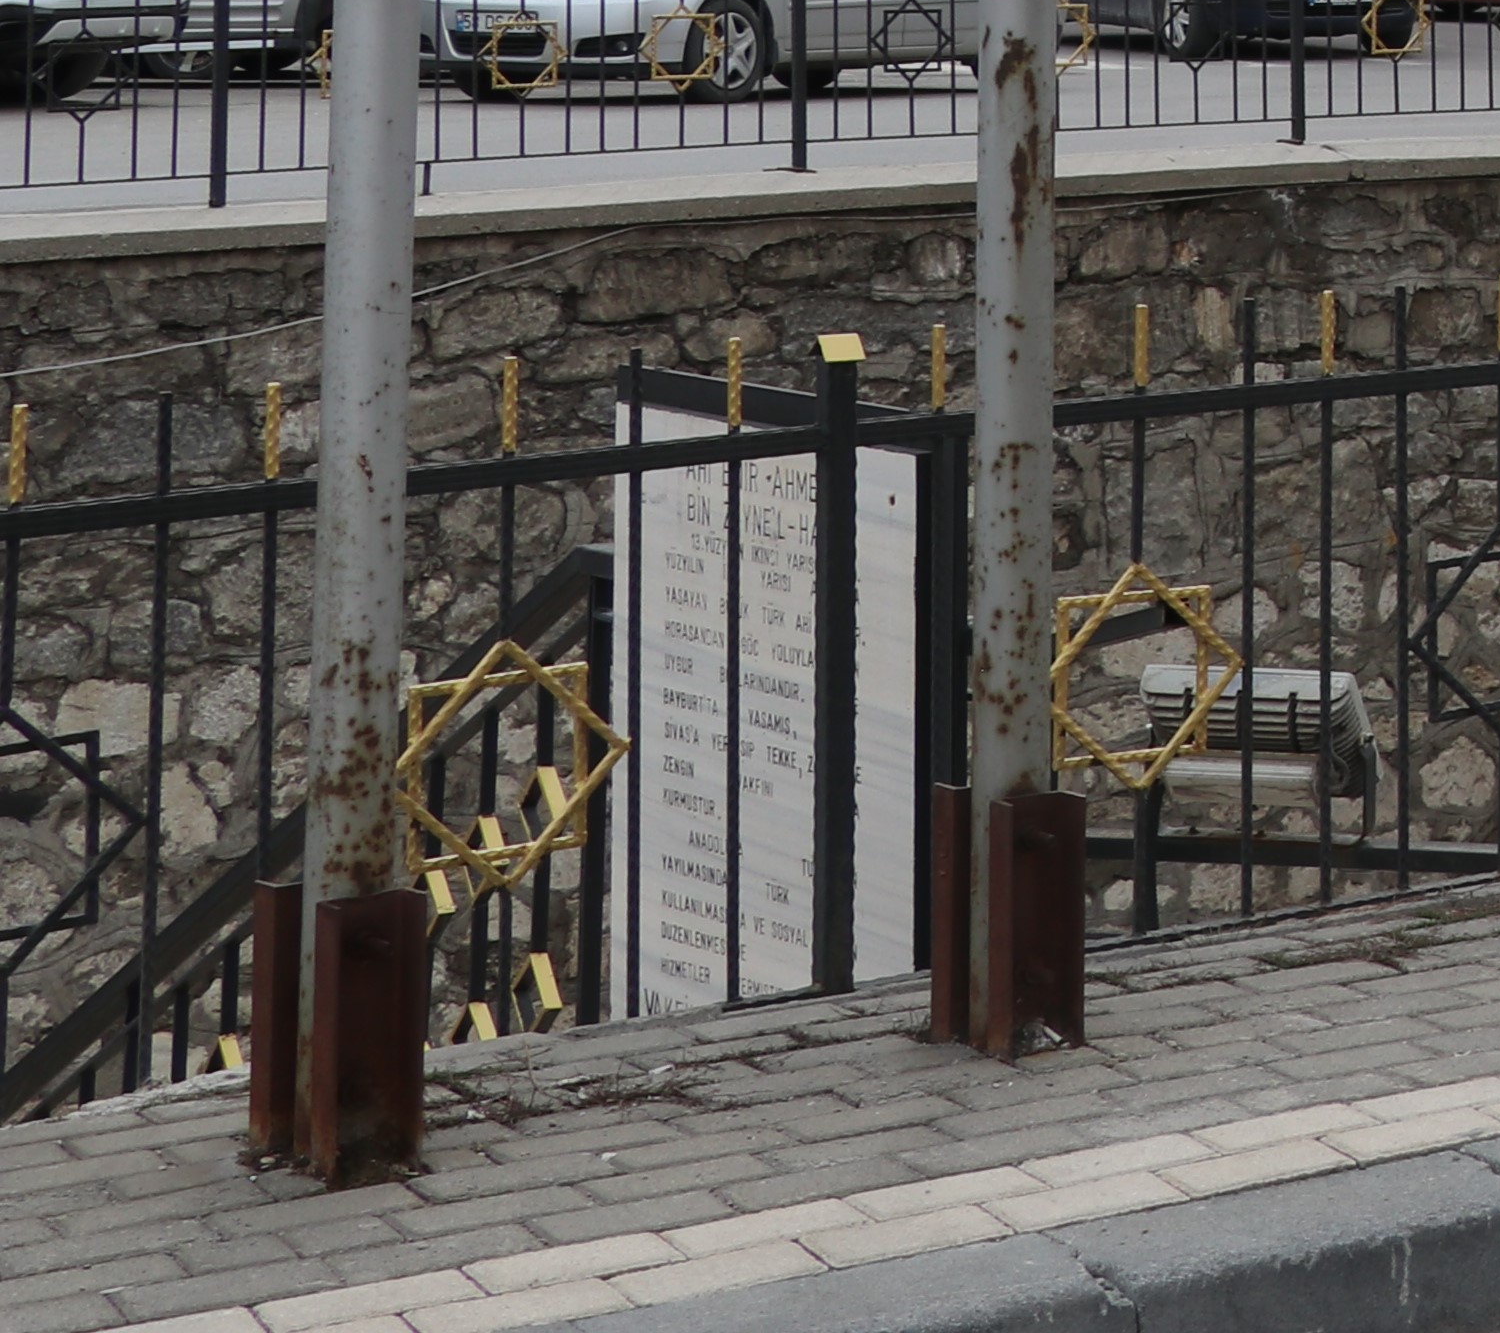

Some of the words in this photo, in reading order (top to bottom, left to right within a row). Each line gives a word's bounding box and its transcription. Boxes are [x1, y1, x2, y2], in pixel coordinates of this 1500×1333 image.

[686, 486, 711, 527] BİN
[665, 586, 707, 612] YAŞAYAN
[761, 602, 785, 628] TÜRK
[664, 653, 694, 676] UYGUR
[664, 715, 700, 746] SİVAS'A
[766, 745, 803, 779] TEKKE,
[765, 876, 790, 906] TÜRK
[753, 915, 765, 936] VE
[771, 920, 808, 948] SOSYAL
